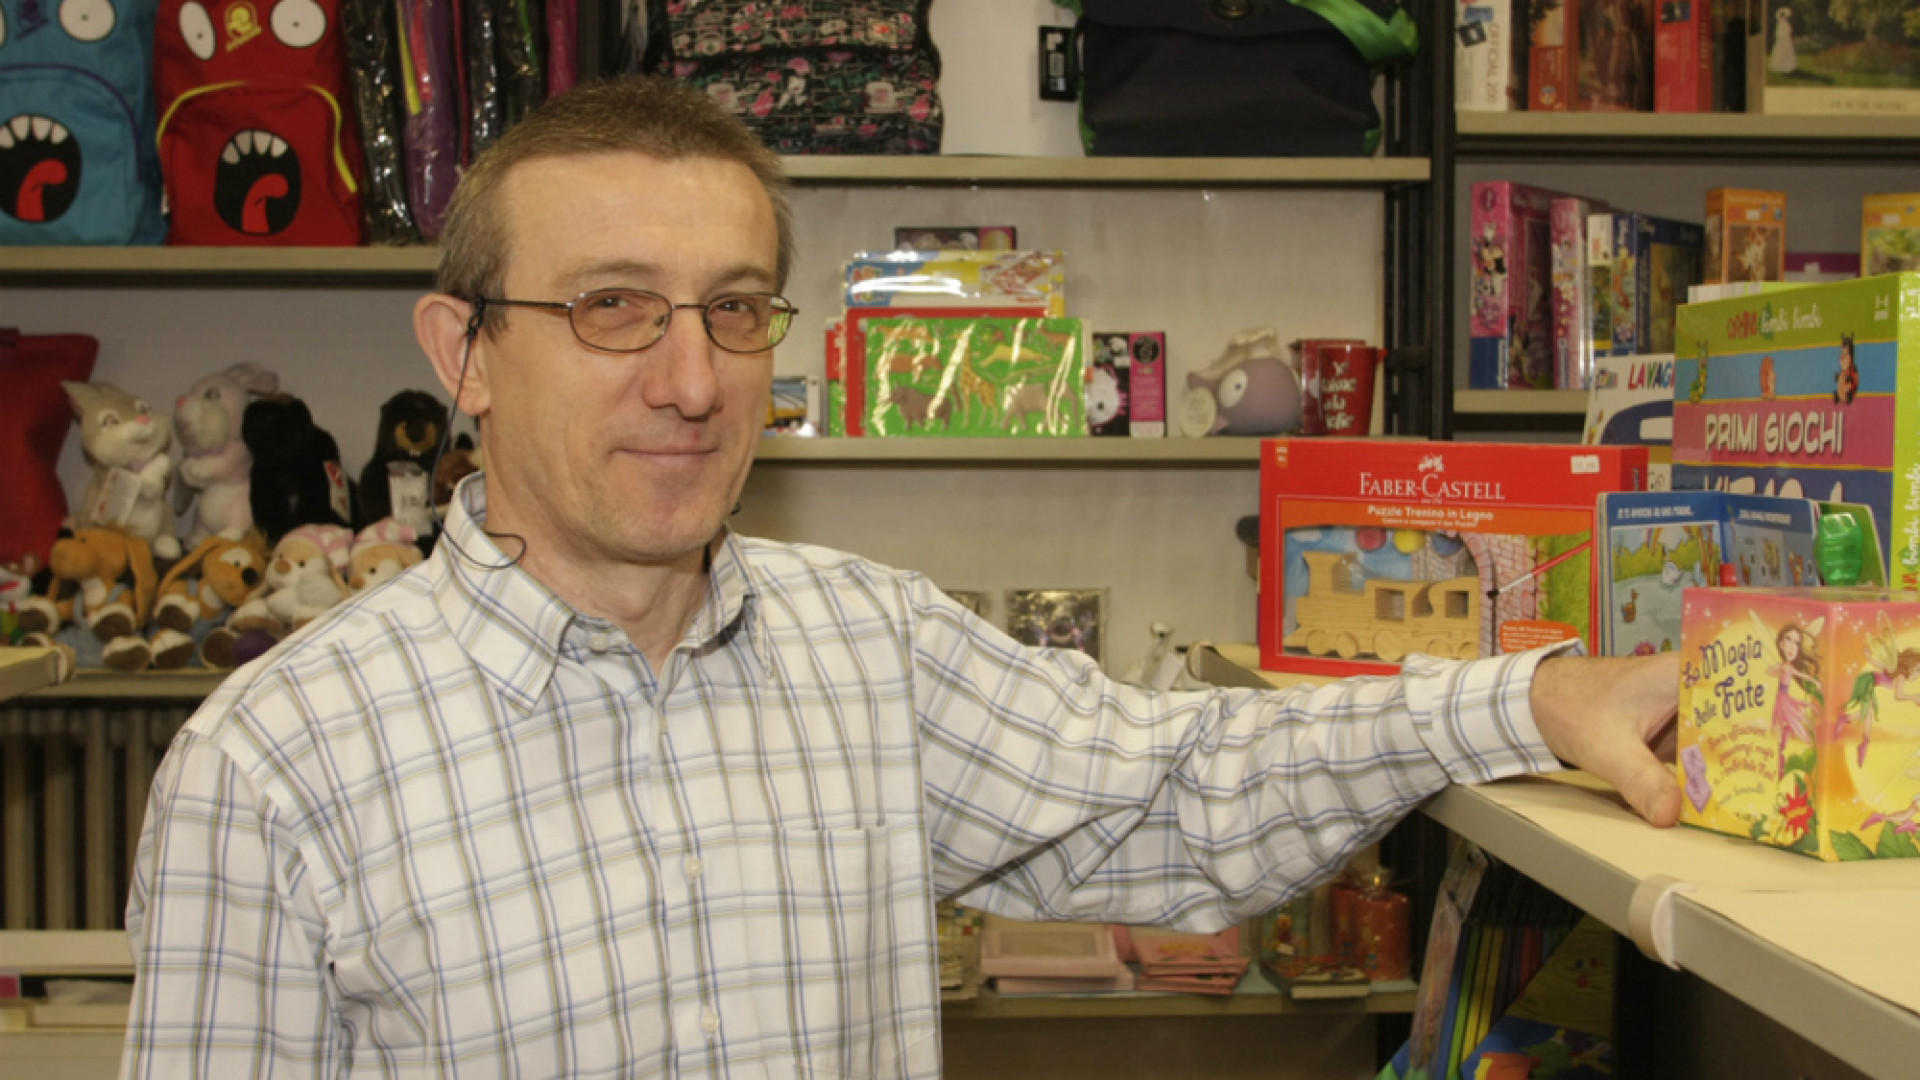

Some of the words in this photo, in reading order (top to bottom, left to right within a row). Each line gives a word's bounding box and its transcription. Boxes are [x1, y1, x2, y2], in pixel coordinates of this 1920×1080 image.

[1704, 413, 1759, 453] PRIMI
[1764, 411, 1844, 455] GIOCHI
[1359, 472, 1505, 499] FABER-CASTELL
[1368, 504, 1402, 516] Puzzle
[1405, 506, 1444, 517] Trenino
[1447, 508, 1457, 518] in
[1460, 509, 1494, 521] Legno
[1699, 636, 1762, 680] Magia
[1714, 677, 1765, 719] Fate
